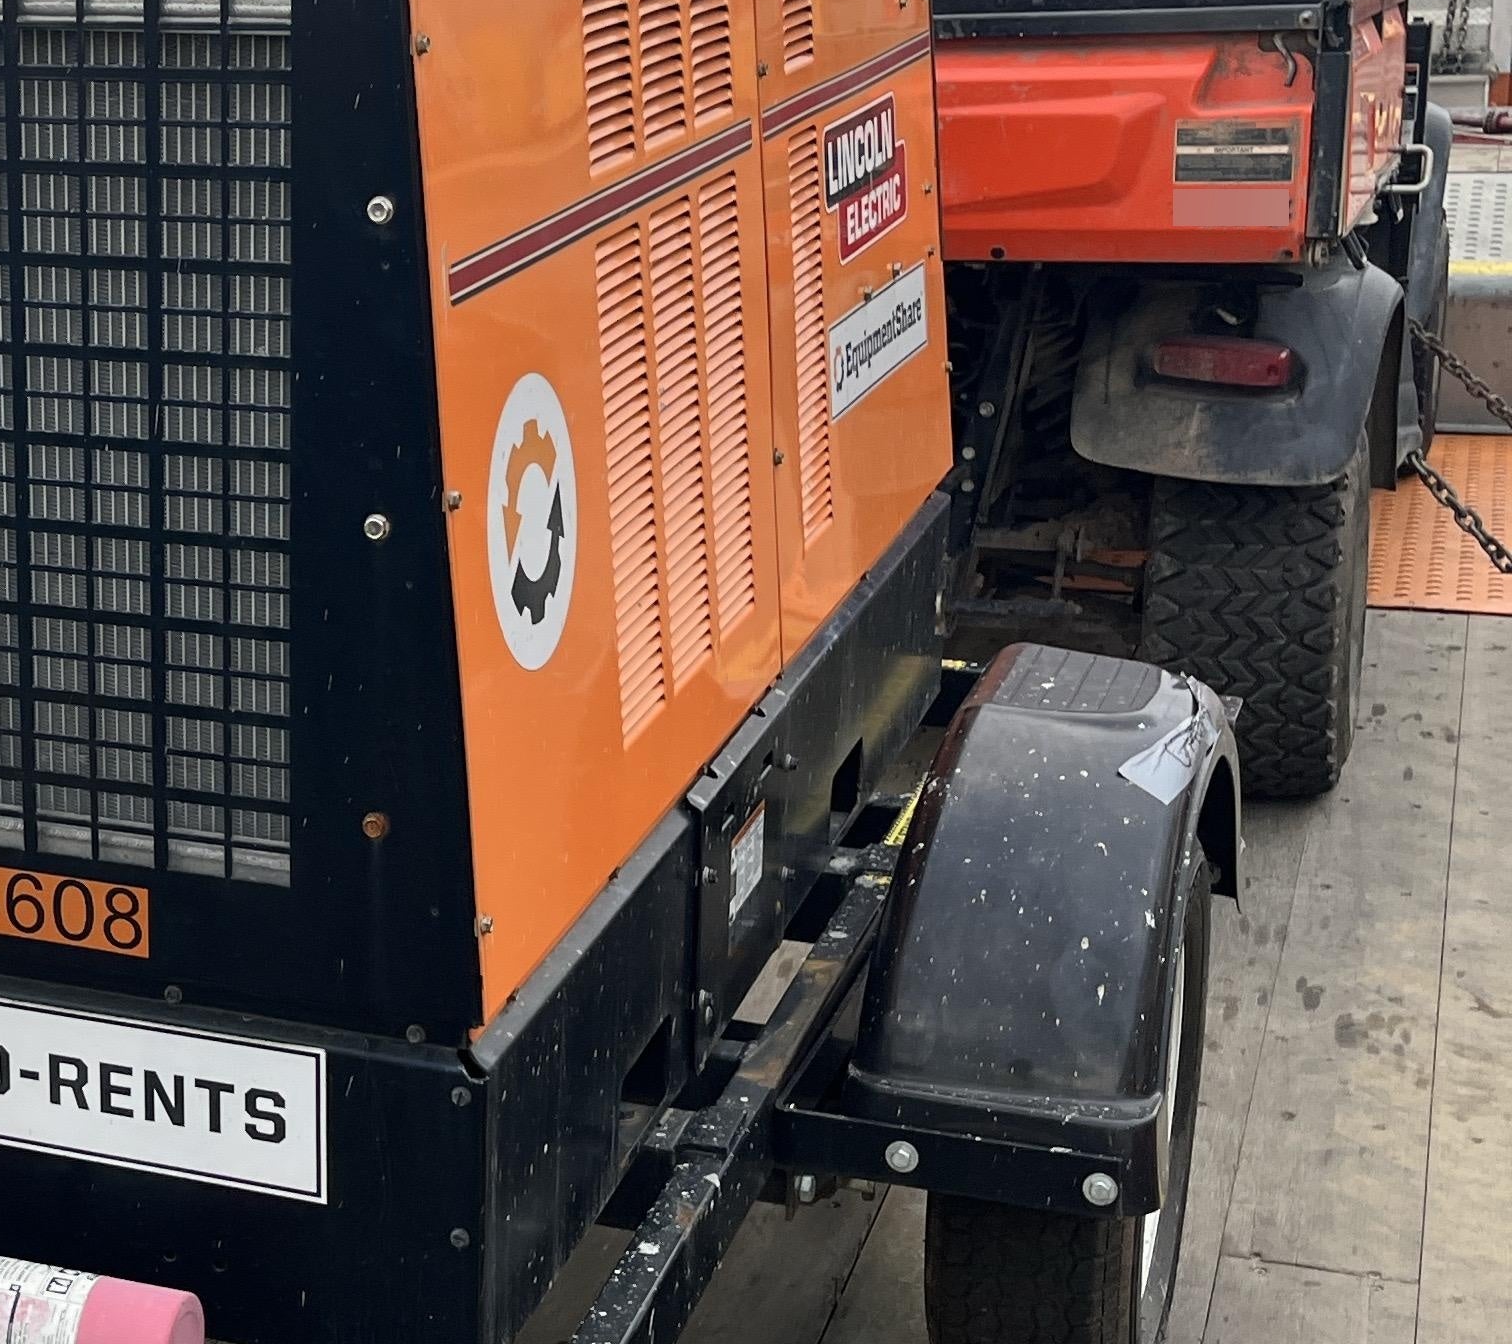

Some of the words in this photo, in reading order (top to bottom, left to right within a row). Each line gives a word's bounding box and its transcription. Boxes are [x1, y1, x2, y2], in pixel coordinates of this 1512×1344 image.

[827, 108, 893, 196] LINCOLN
[846, 173, 902, 246] ELECTRIC
[845, 296, 923, 379] EquipmentShare
